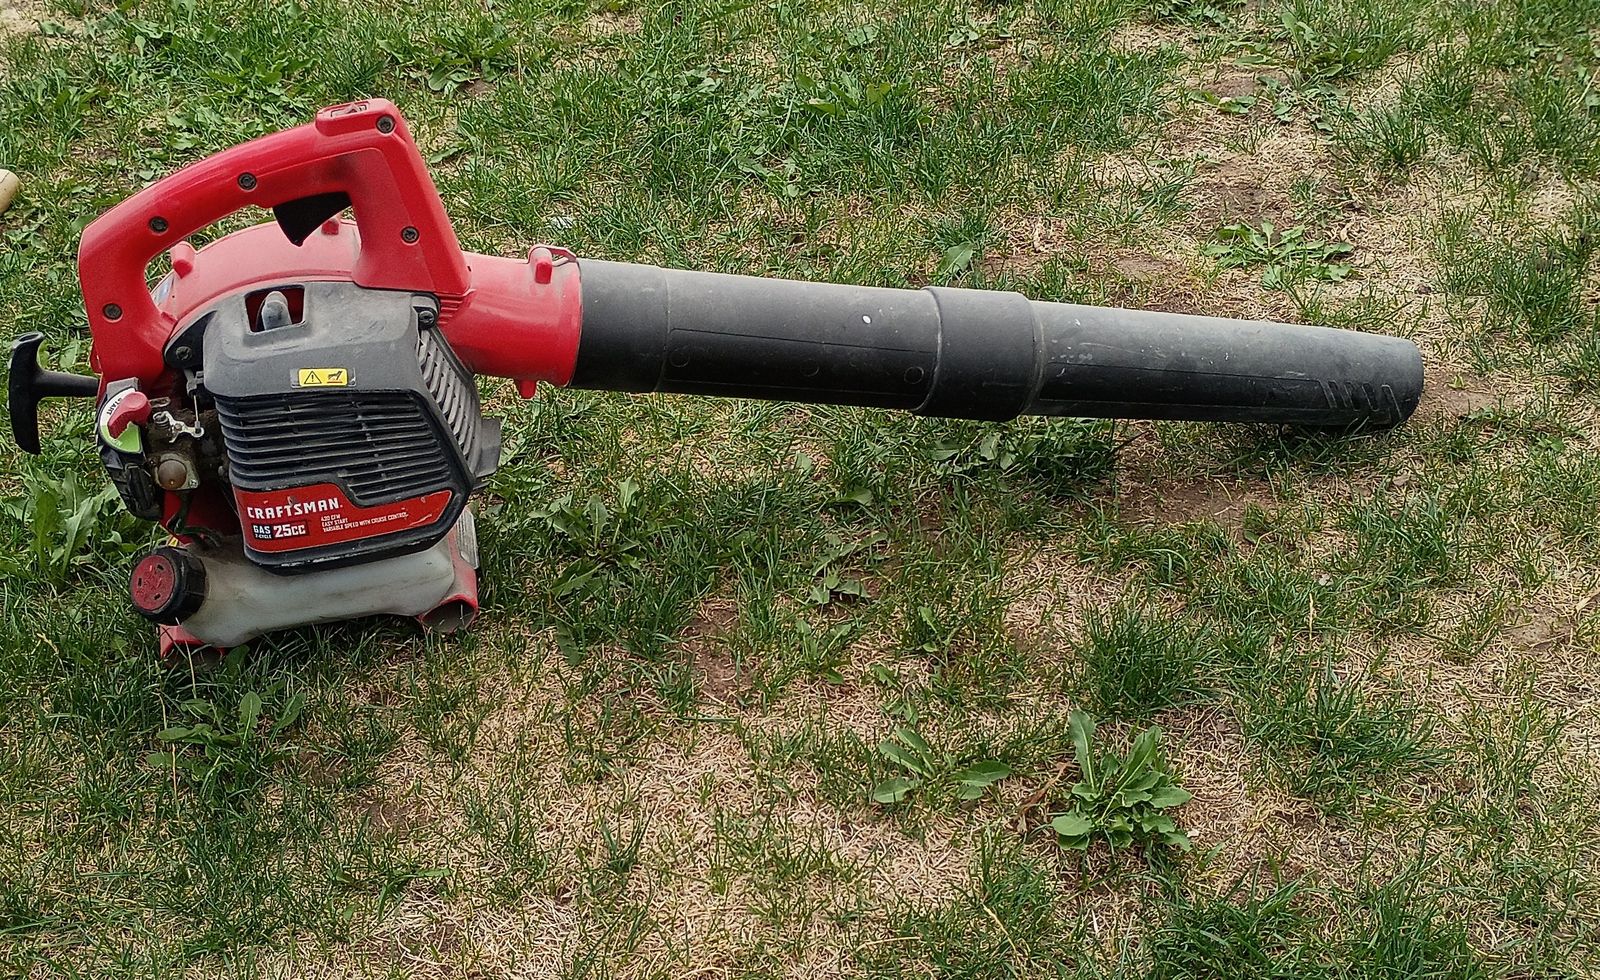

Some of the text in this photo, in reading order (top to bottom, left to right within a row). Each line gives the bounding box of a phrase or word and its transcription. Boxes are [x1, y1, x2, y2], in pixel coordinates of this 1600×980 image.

[253, 524, 271, 534] GAS
[322, 512, 408, 533] VARIABLE SPEED WITH CRUISE CONTROL
